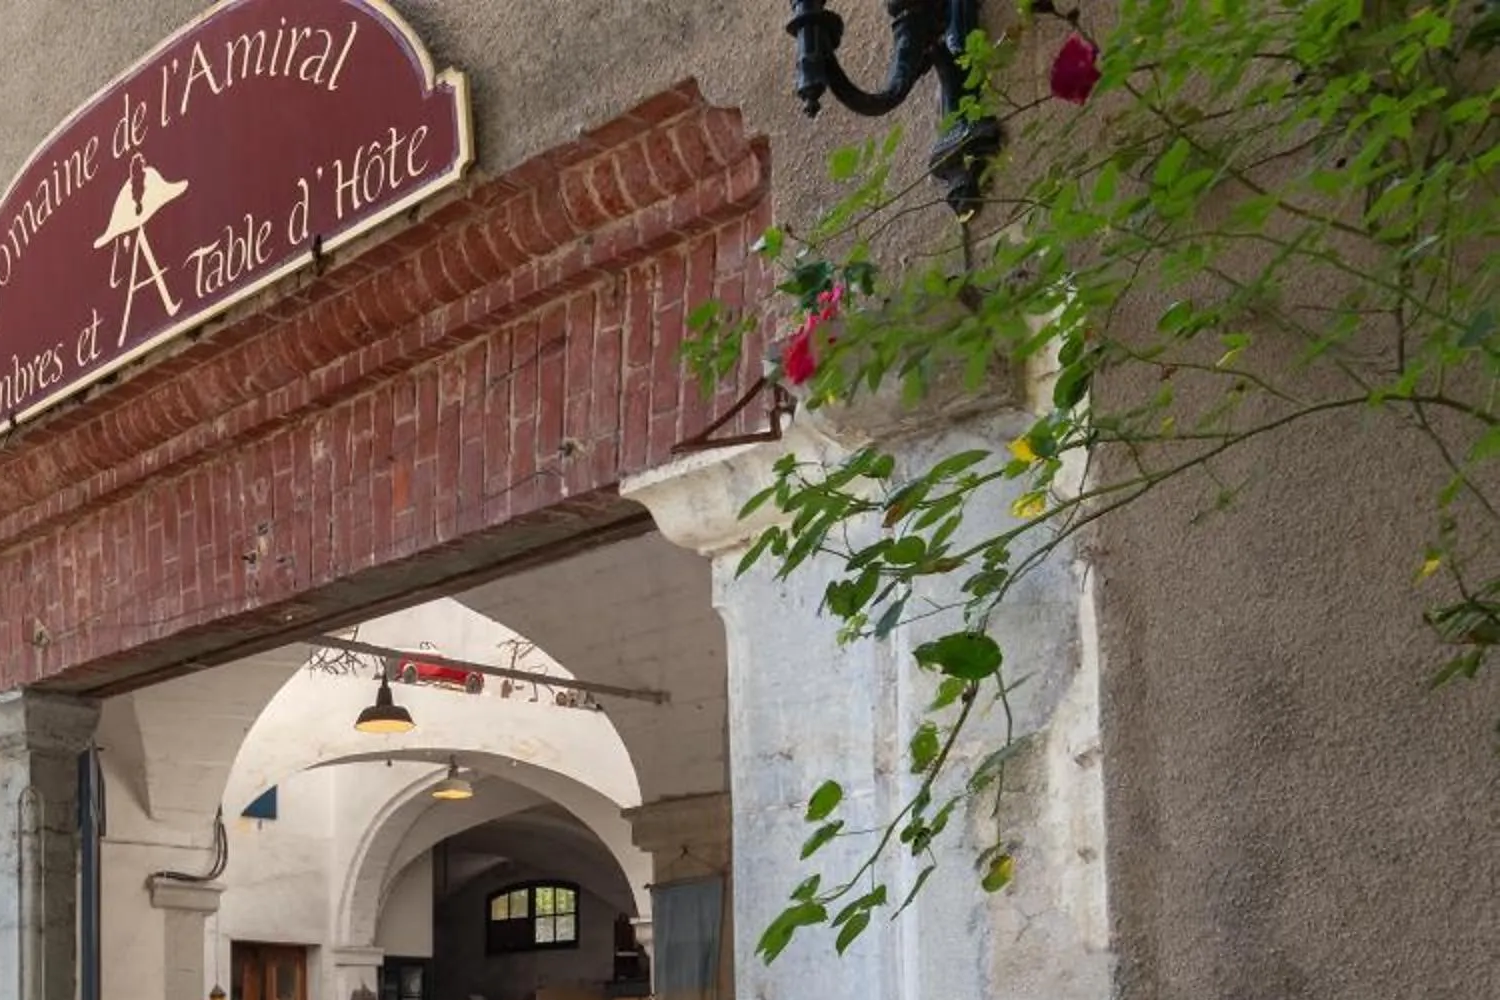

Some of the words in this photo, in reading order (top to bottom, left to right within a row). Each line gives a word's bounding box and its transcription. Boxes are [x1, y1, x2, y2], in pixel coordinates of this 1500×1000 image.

[112, 93, 149, 158] de
[160, 16, 358, 128] l'Amiral
[185, 213, 274, 299] Table
[76, 309, 103, 368] et
